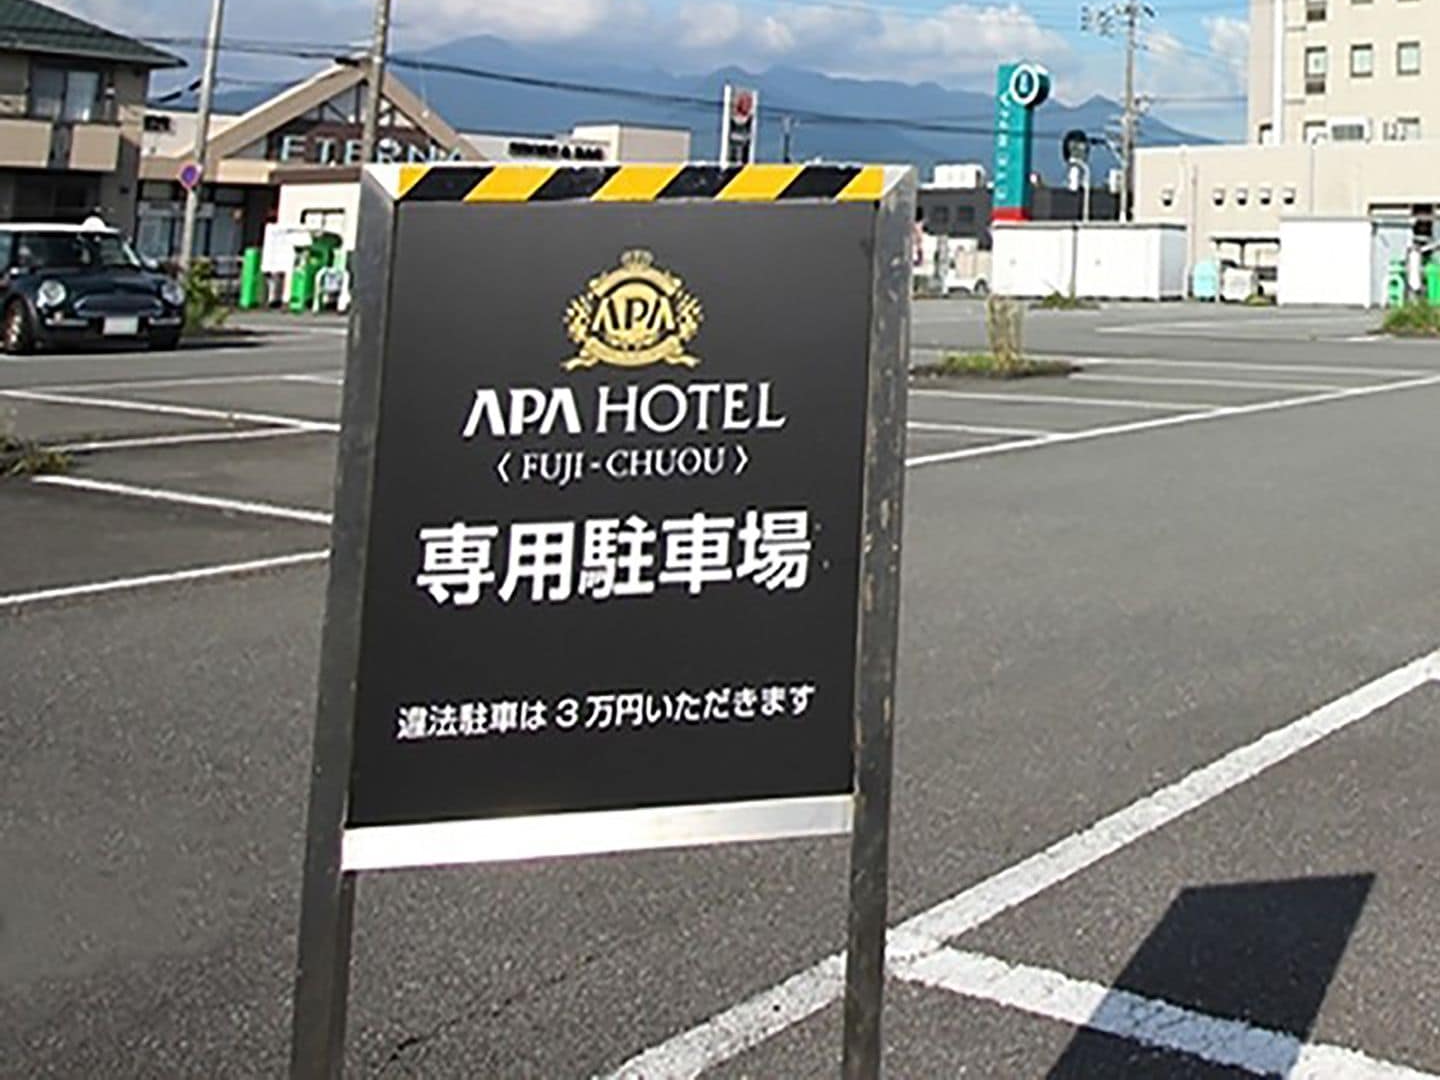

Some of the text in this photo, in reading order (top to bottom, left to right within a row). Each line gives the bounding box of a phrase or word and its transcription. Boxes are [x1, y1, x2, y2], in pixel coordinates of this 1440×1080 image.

[591, 296, 677, 332] APA
[462, 382, 786, 437] APA HOTEL
[416, 510, 812, 606] 専用駐車場
